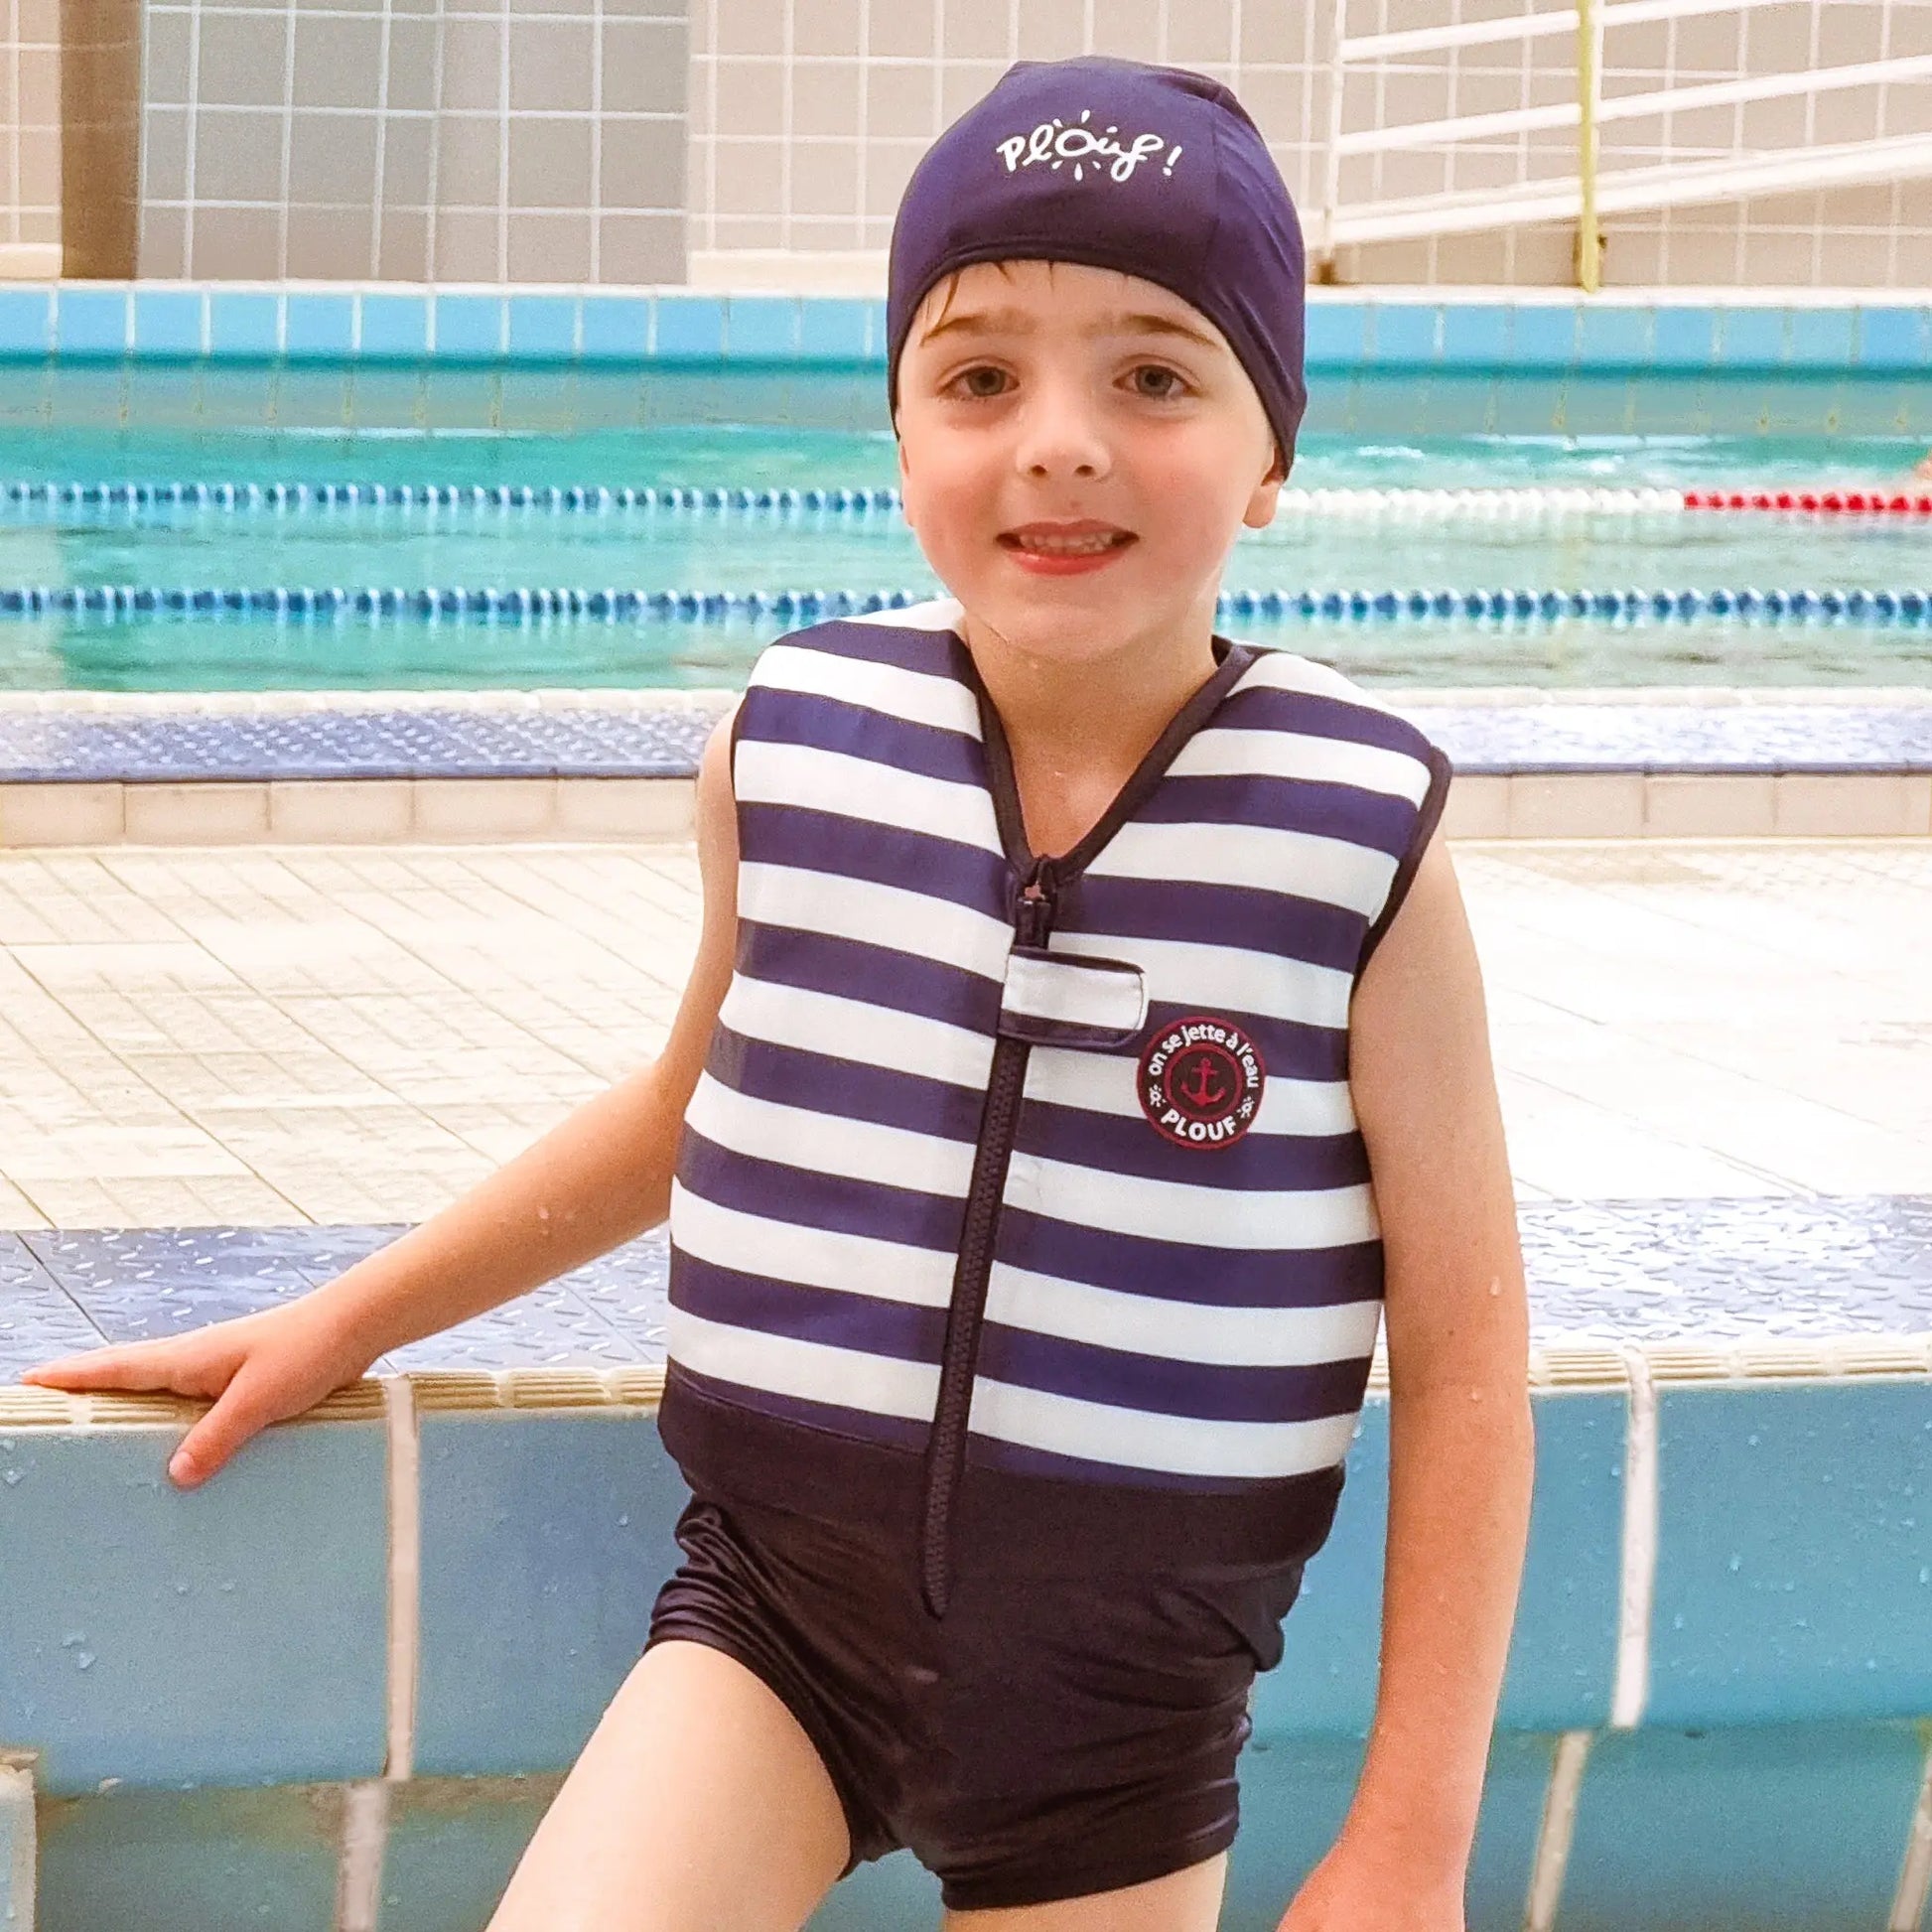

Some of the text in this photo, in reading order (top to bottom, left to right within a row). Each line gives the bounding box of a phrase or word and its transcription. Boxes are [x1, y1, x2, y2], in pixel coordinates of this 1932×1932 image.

[1149, 1025, 1259, 1087] on se jette à l'eau
[1161, 1108, 1236, 1141] PLOUF
